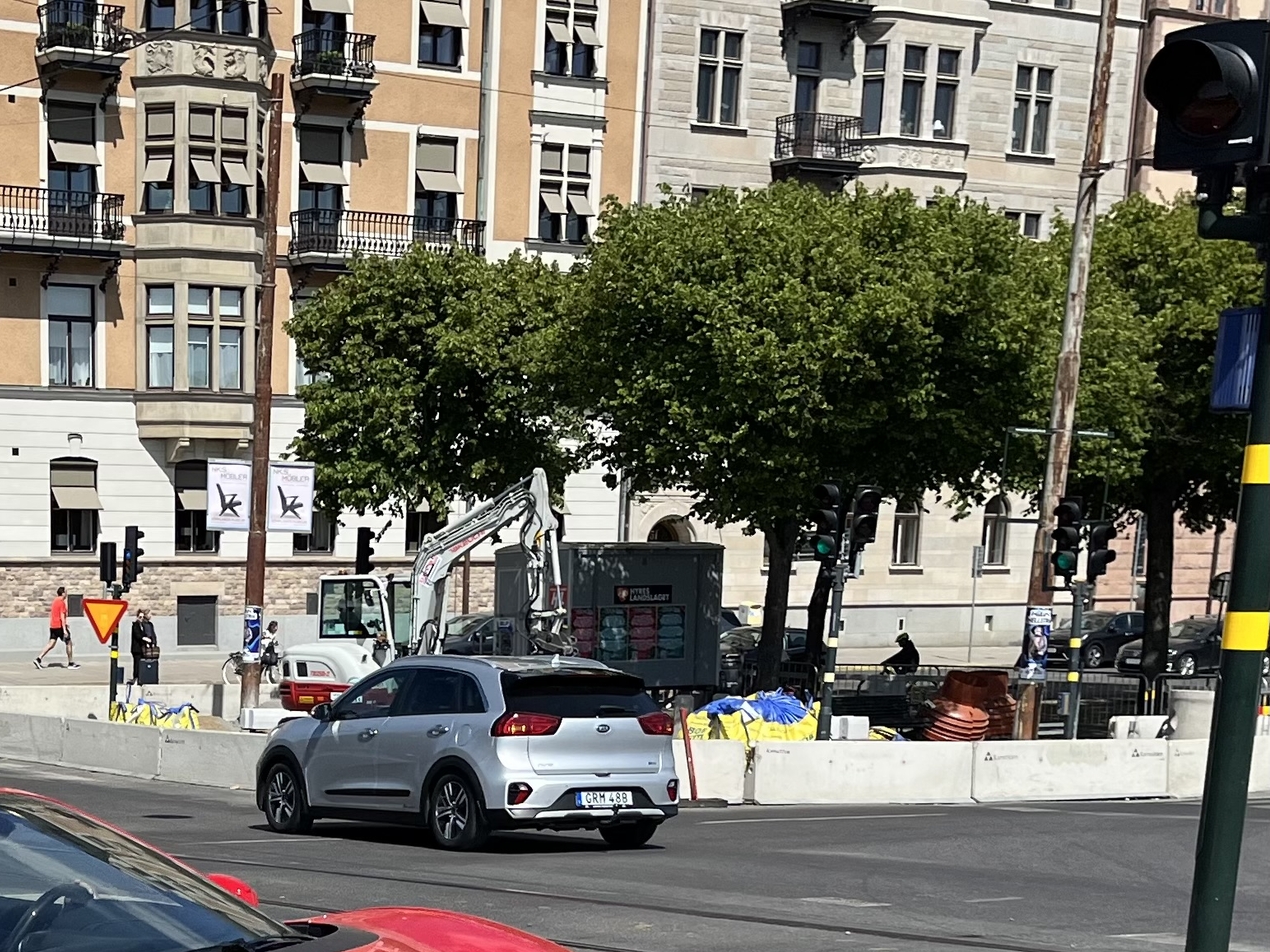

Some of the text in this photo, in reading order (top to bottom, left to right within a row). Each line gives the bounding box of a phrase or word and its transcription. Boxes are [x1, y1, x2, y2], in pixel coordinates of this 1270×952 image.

[220, 472, 247, 480] MÖBLER
[282, 474, 309, 482] MÖBLER
[585, 792, 606, 804] GRM
